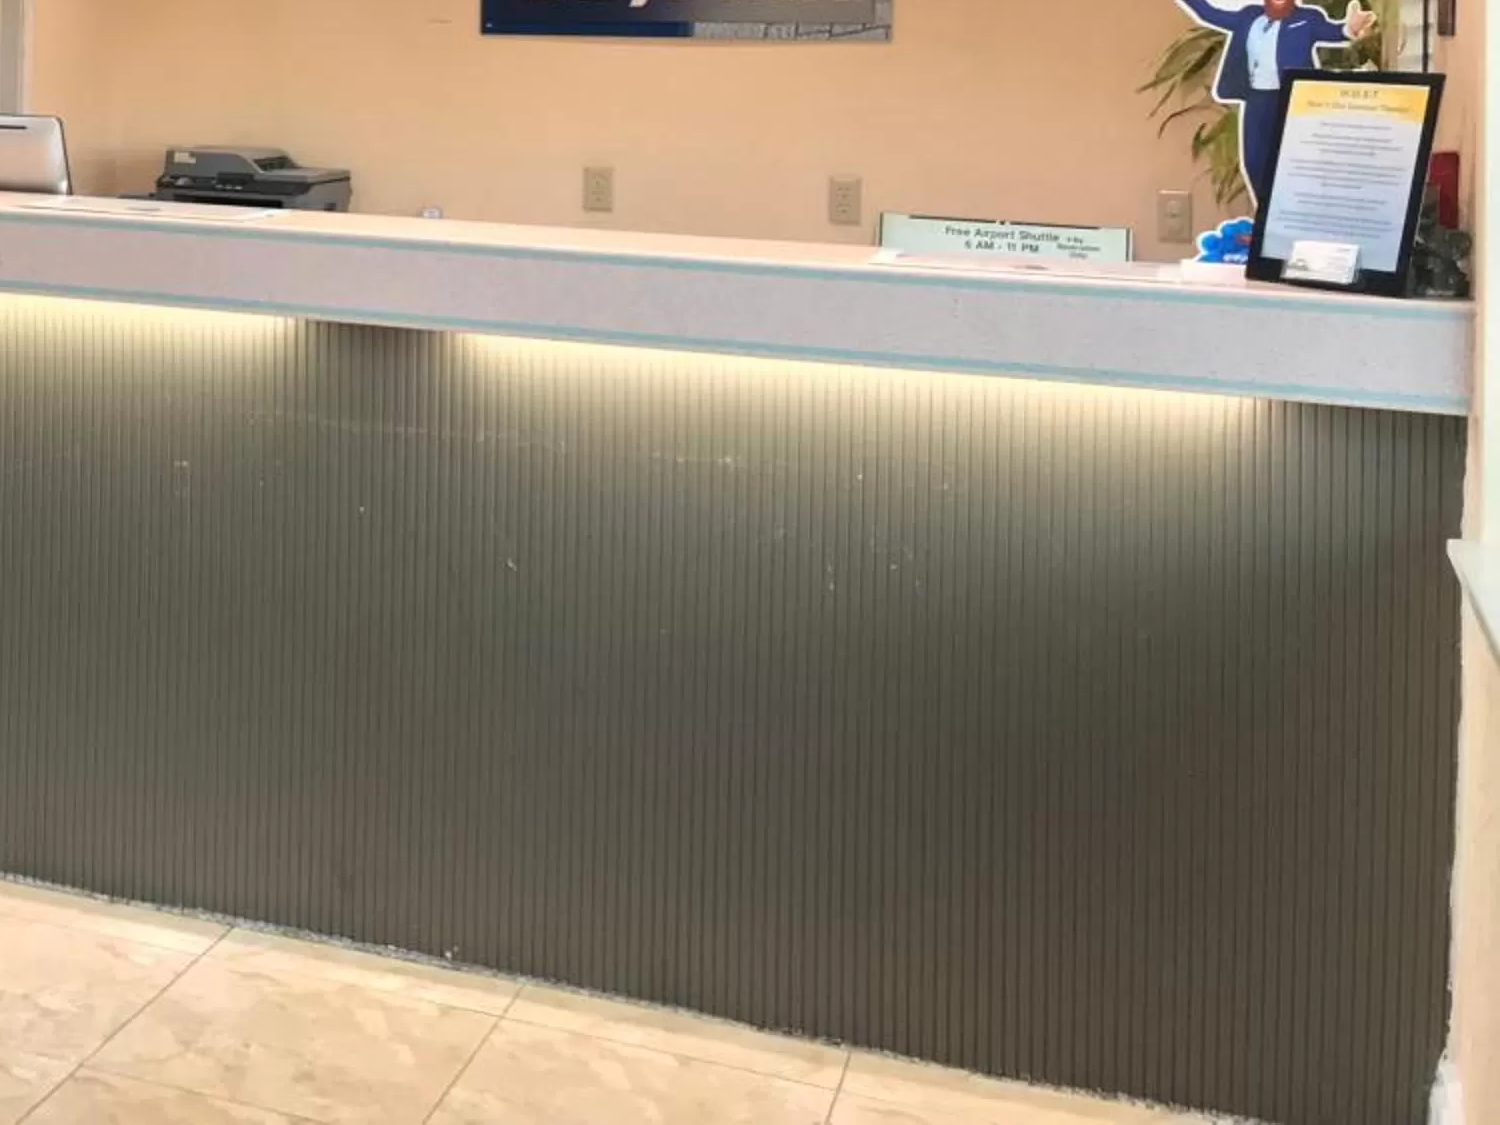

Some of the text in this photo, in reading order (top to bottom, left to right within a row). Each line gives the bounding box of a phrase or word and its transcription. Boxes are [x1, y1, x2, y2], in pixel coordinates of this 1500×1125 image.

[945, 226, 1060, 242] Free Airport Shuttle
[975, 240, 994, 251] AM
[1021, 243, 1039, 253] PM
